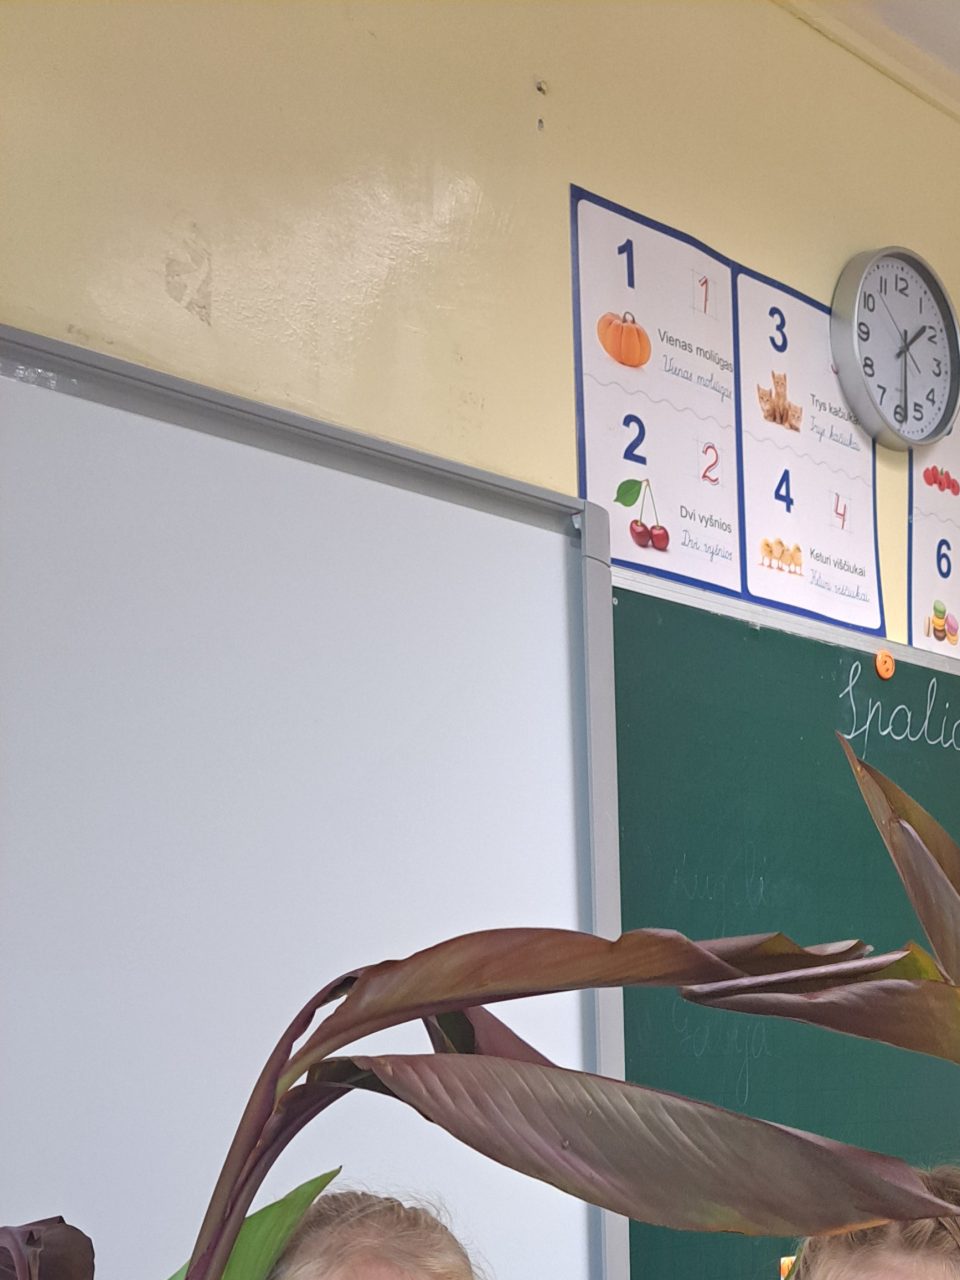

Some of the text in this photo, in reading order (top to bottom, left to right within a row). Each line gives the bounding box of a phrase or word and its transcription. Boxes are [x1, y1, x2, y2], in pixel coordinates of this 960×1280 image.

[617, 238, 635, 289] 1
[697, 275, 709, 314] 1
[879, 275, 888, 296] 11
[894, 274, 909, 297] 12
[863, 291, 876, 313] 10
[918, 296, 924, 315] 1
[768, 306, 789, 353] 3
[857, 321, 871, 342] 9
[926, 325, 938, 345] 2
[658, 327, 733, 373] Vienas moliūgas
[862, 356, 875, 378] 8
[932, 358, 942, 377] 3
[810, 393, 827, 412] Trys
[876, 384, 887, 406] 7
[925, 388, 936, 406] 4
[893, 404, 907, 424] 6
[912, 401, 924, 421] 5
[622, 413, 648, 466] 2
[701, 442, 719, 486] 2
[774, 469, 794, 513] 4
[680, 505, 732, 533] Dvi vyšnios
[833, 492, 848, 530] 4
[810, 547, 832, 566] Keturi
[936, 538, 952, 579] 6
